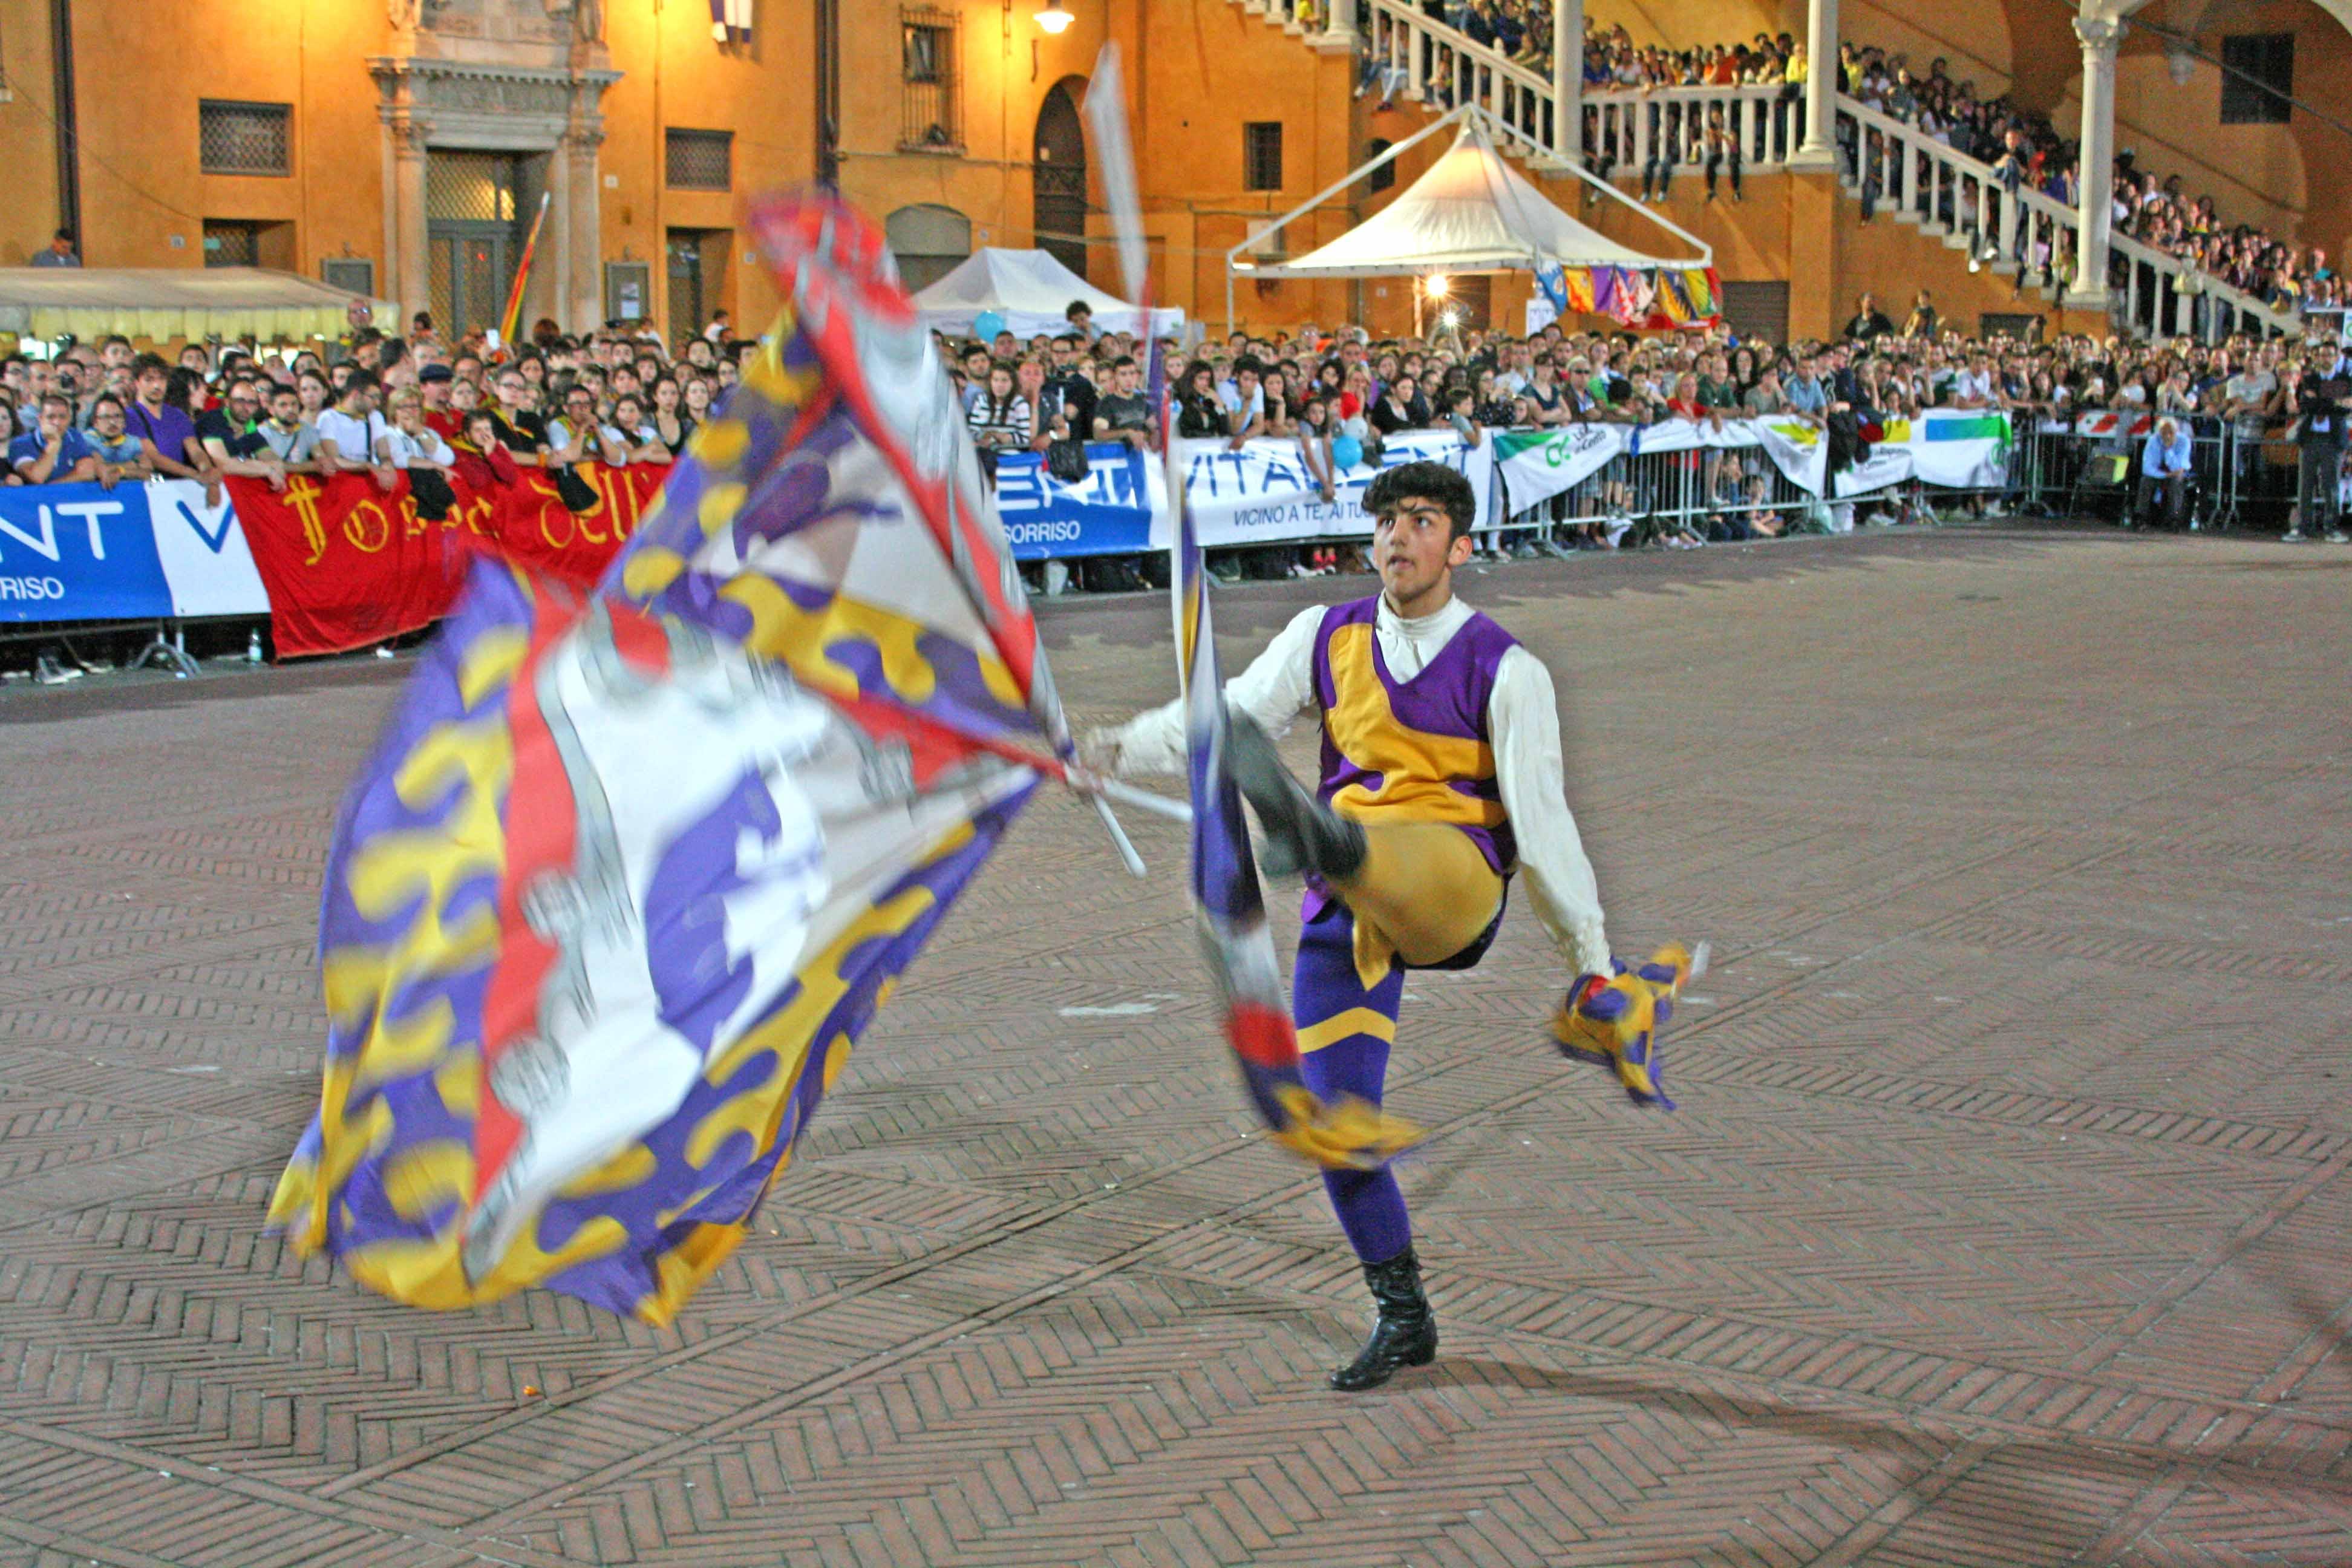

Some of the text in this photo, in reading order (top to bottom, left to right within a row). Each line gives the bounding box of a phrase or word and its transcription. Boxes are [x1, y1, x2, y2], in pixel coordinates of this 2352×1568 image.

[1234, 505, 1284, 526] VICINO
[1289, 505, 1299, 522] A
[1004, 520, 1080, 544] SORRISO
